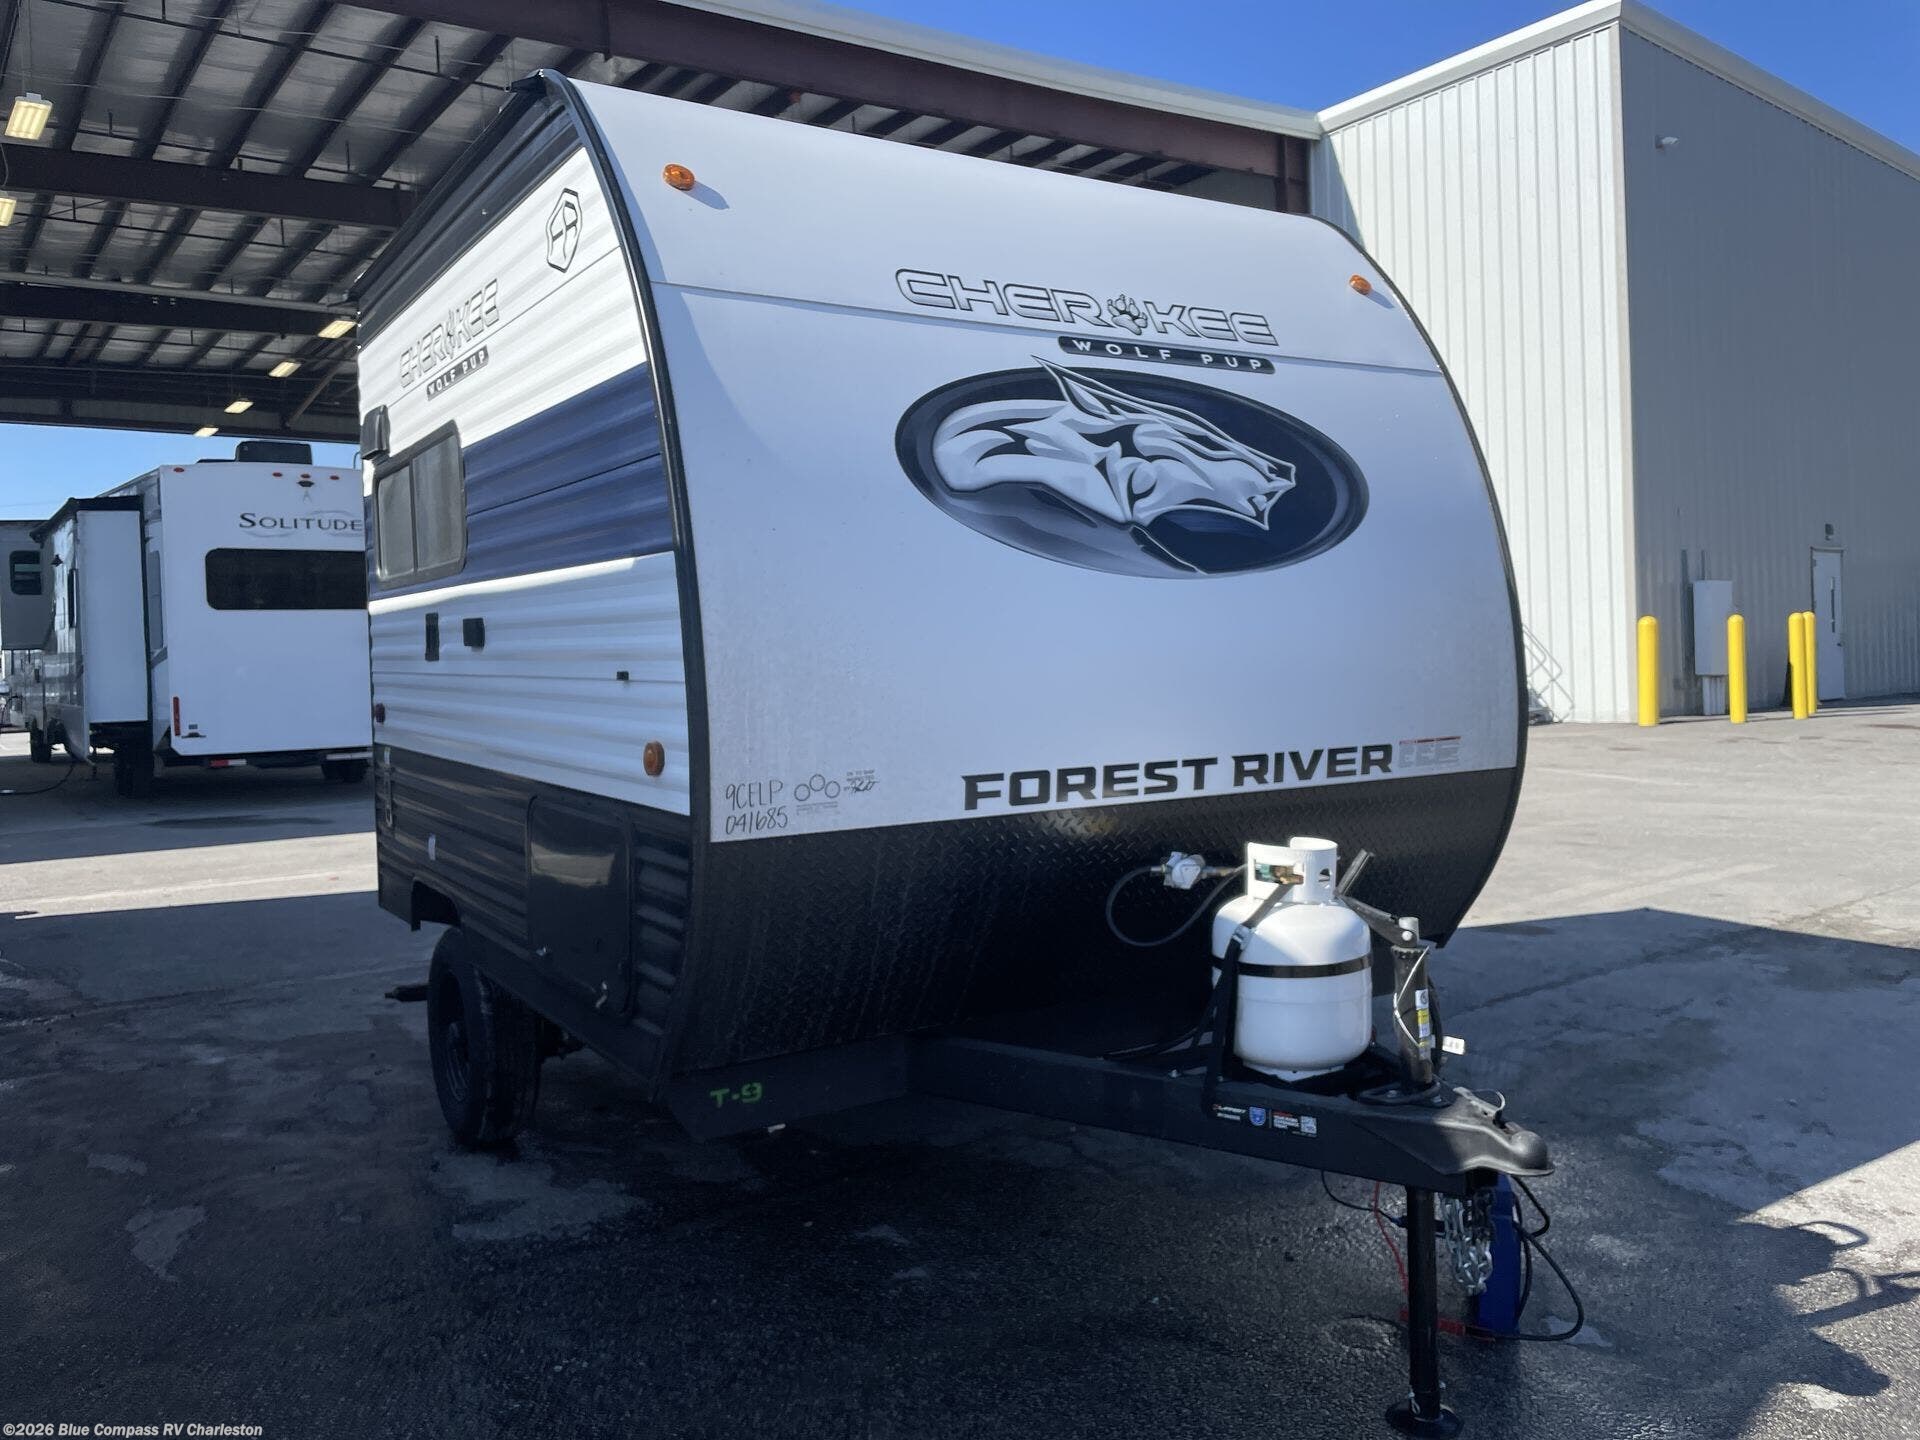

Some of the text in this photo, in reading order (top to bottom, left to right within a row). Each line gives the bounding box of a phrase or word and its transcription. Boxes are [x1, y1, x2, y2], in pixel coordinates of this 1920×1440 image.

[427, 348, 487, 397] WOLF PUP
[1071, 338, 1264, 371] WOLF PUP
[961, 756, 1218, 811] FOREST
[1231, 743, 1394, 787] RIVER
